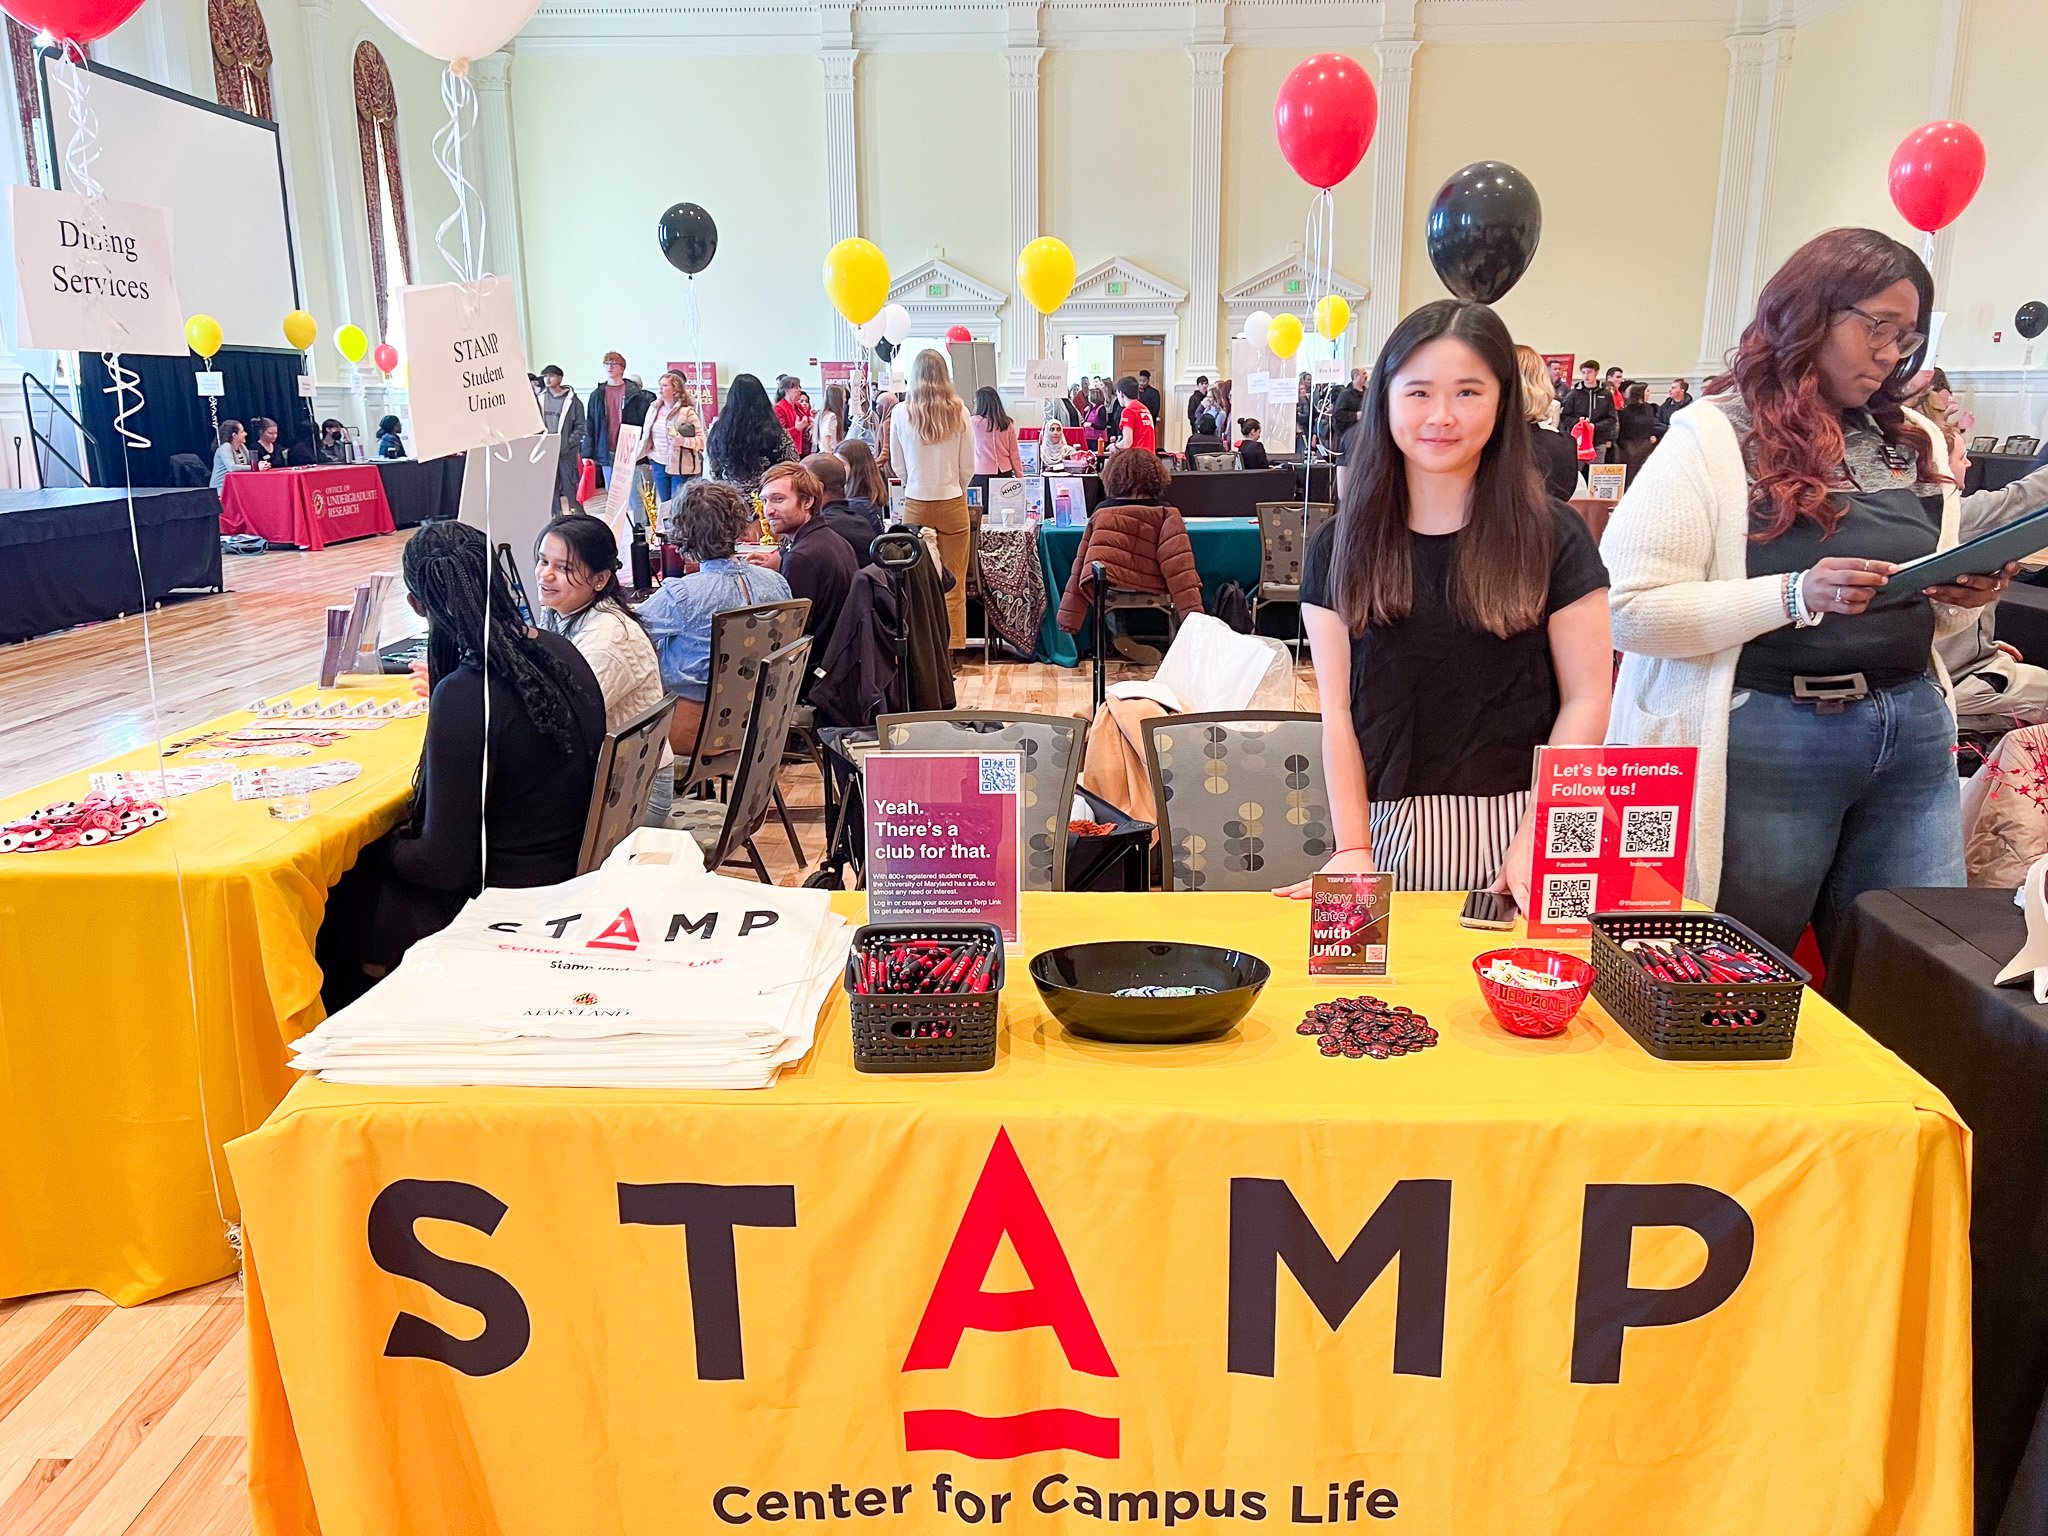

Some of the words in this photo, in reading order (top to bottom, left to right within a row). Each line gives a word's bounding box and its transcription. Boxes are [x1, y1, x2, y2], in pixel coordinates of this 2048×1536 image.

[58, 220, 138, 262] Dining
[53, 265, 149, 299] Services
[454, 333, 498, 362] STAMP
[463, 367, 504, 388] Student
[469, 392, 506, 411] Union
[326, 486, 342, 494] OFFICE
[327, 490, 378, 506] UNDERGRADUATE
[328, 504, 359, 517] RESEARCH
[1553, 764, 1592, 777] Let's
[1597, 763, 1617, 776] be
[1622, 763, 1683, 776] friends.
[1552, 783, 1605, 796] Follow
[1610, 782, 1636, 796] us!
[874, 800, 924, 814] Yeah.
[874, 821, 942, 836] There's
[948, 824, 958, 836] a
[875, 844, 914, 859] club
[920, 844, 945, 858] for
[950, 844, 991, 858] that.
[1315, 892, 1352, 907] Stay
[1356, 893, 1377, 908] up
[1314, 909, 1347, 921] late
[1314, 926, 1351, 939] with
[1313, 945, 1356, 957] UMD.
[367, 1125, 1755, 1383] STAMP
[712, 1481, 912, 1526] Center
[932, 1474, 1012, 1524] for
[1032, 1475, 1268, 1526] Campus
[1291, 1480, 1400, 1525] Life
